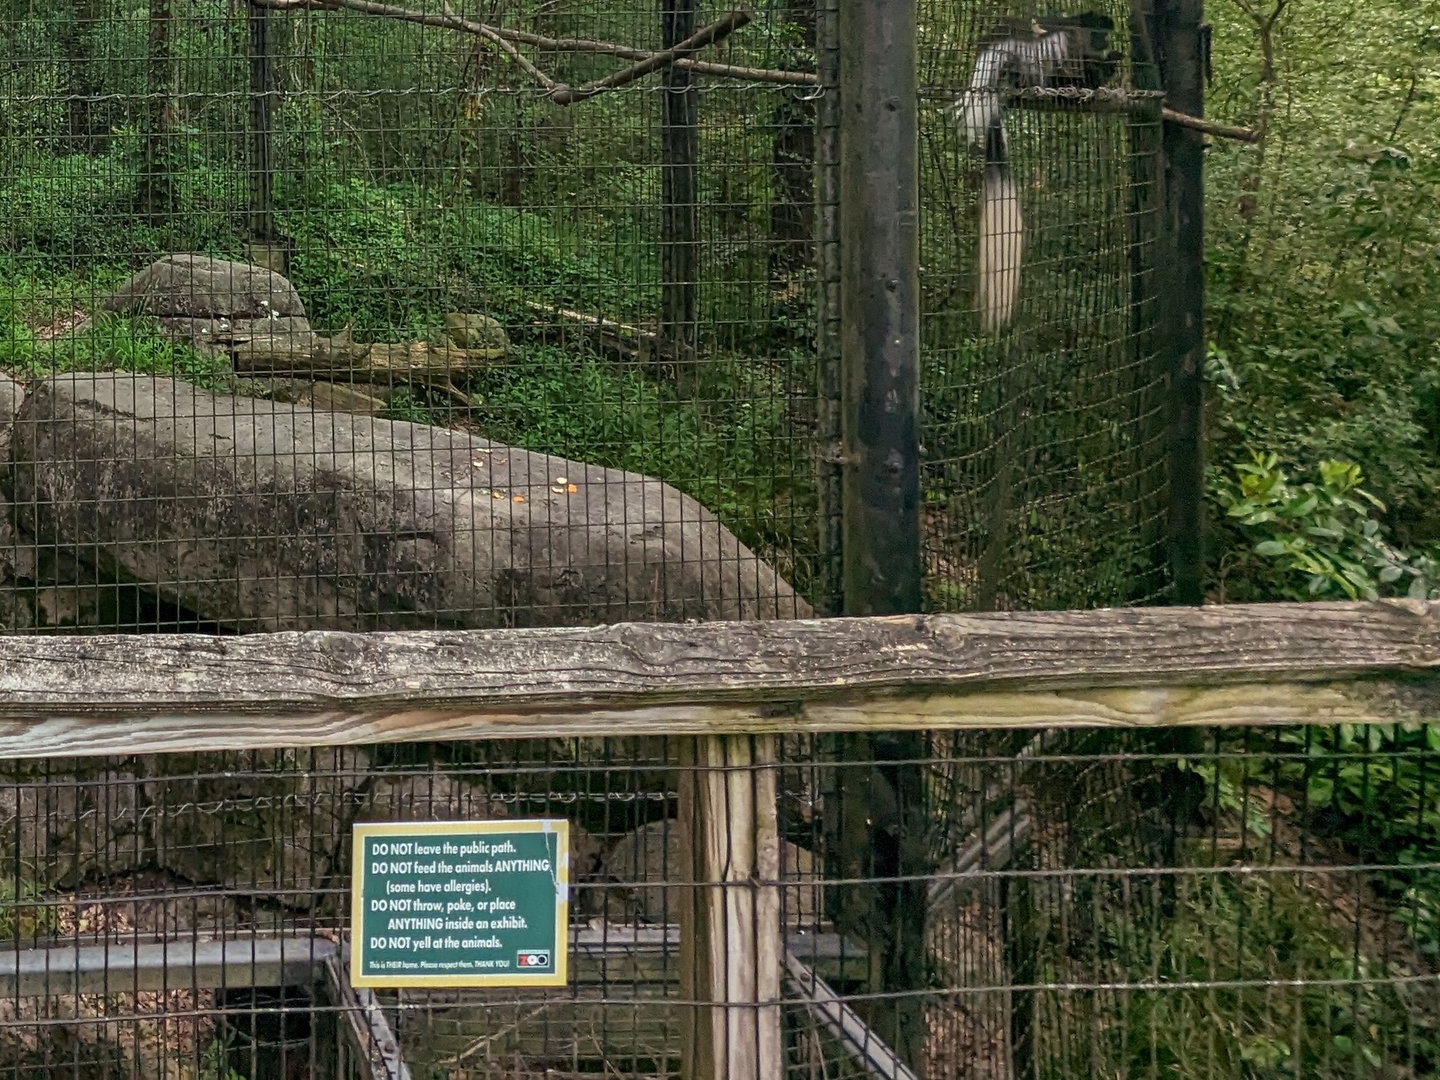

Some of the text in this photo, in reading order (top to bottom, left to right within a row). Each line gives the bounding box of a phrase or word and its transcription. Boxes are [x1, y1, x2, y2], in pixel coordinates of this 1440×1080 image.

[372, 840, 516, 858] DO NOT leave the public path.
[371, 859, 550, 875] DO NOT feed the animals ANYTHING
[386, 879, 492, 895] (some have allergies).
[371, 897, 516, 914] DO NOT throw, poke, or place
[388, 916, 528, 930] ANYTHING inside an exhibit.
[370, 935, 503, 952] DO NOT yell at the animals.
[369, 960, 380, 969] This
[380, 960, 386, 969] is
[386, 960, 402, 969] THEIR
[420, 960, 438, 969] Please
[438, 960, 458, 970] respect
[458, 959, 474, 968] them.
[474, 959, 495, 968] THANK
